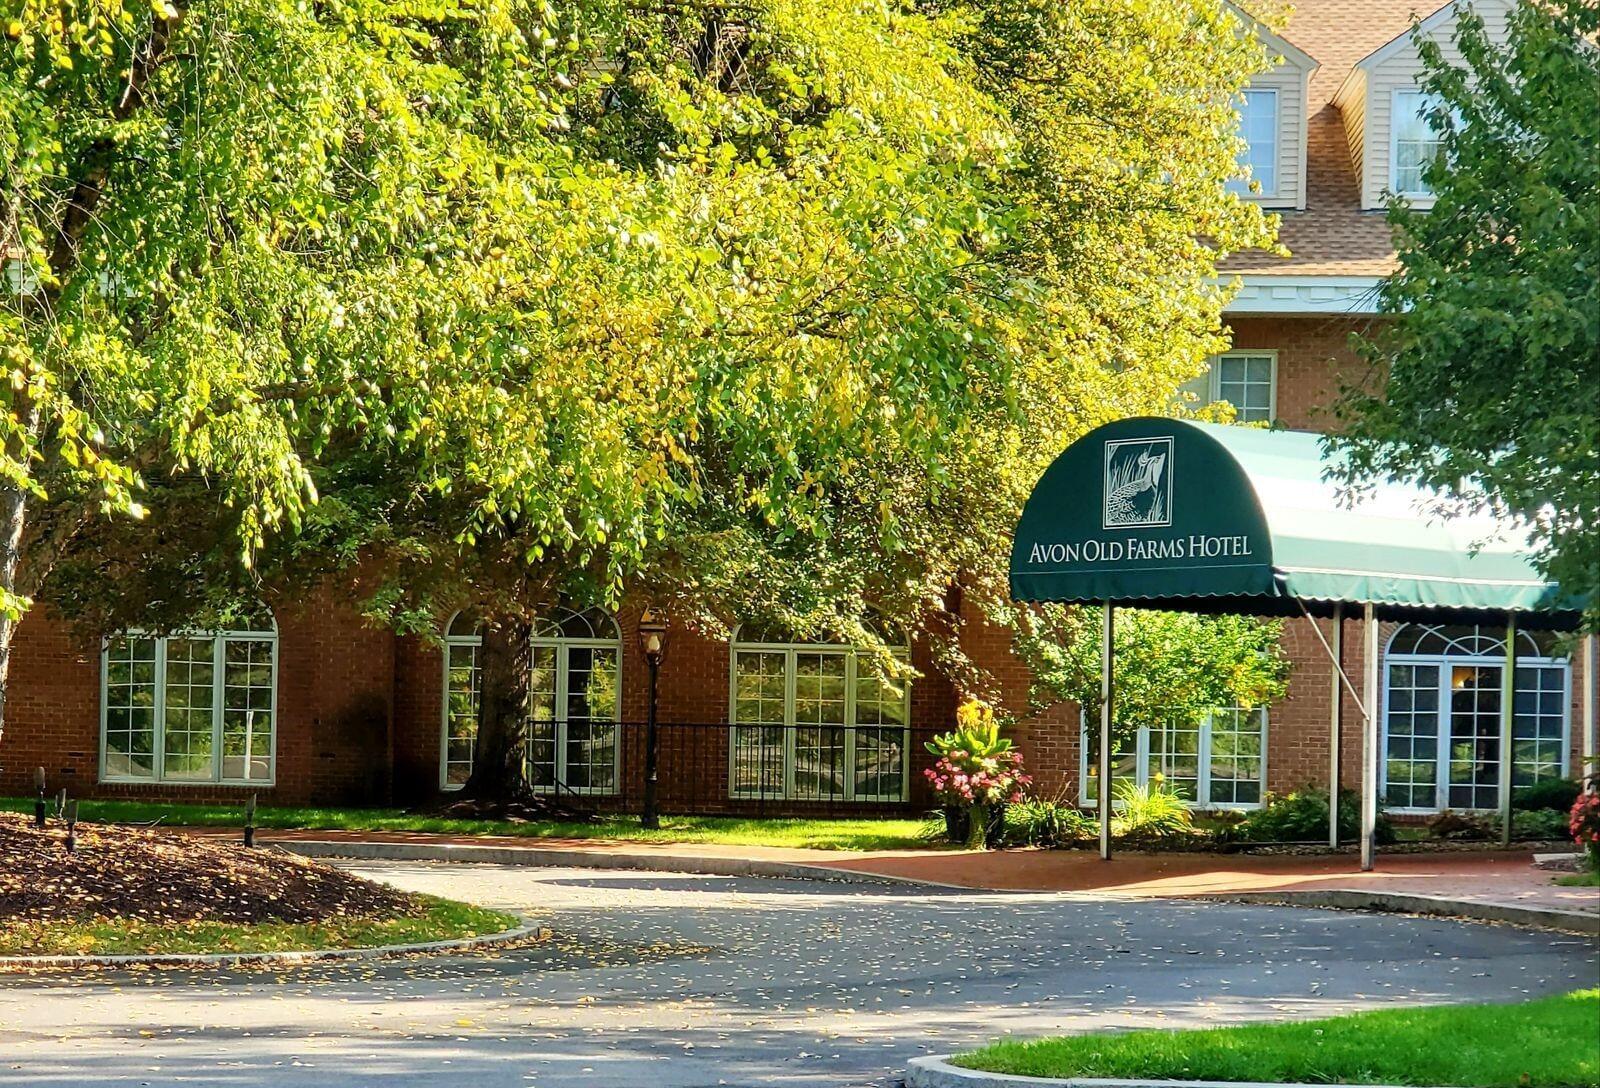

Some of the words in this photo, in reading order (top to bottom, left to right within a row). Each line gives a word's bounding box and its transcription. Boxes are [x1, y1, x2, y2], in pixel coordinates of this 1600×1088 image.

[1028, 542, 1079, 564] AVON
[1083, 539, 1123, 562] OLD
[1127, 538, 1184, 560] FARMS
[1189, 535, 1252, 558] HOTEL
